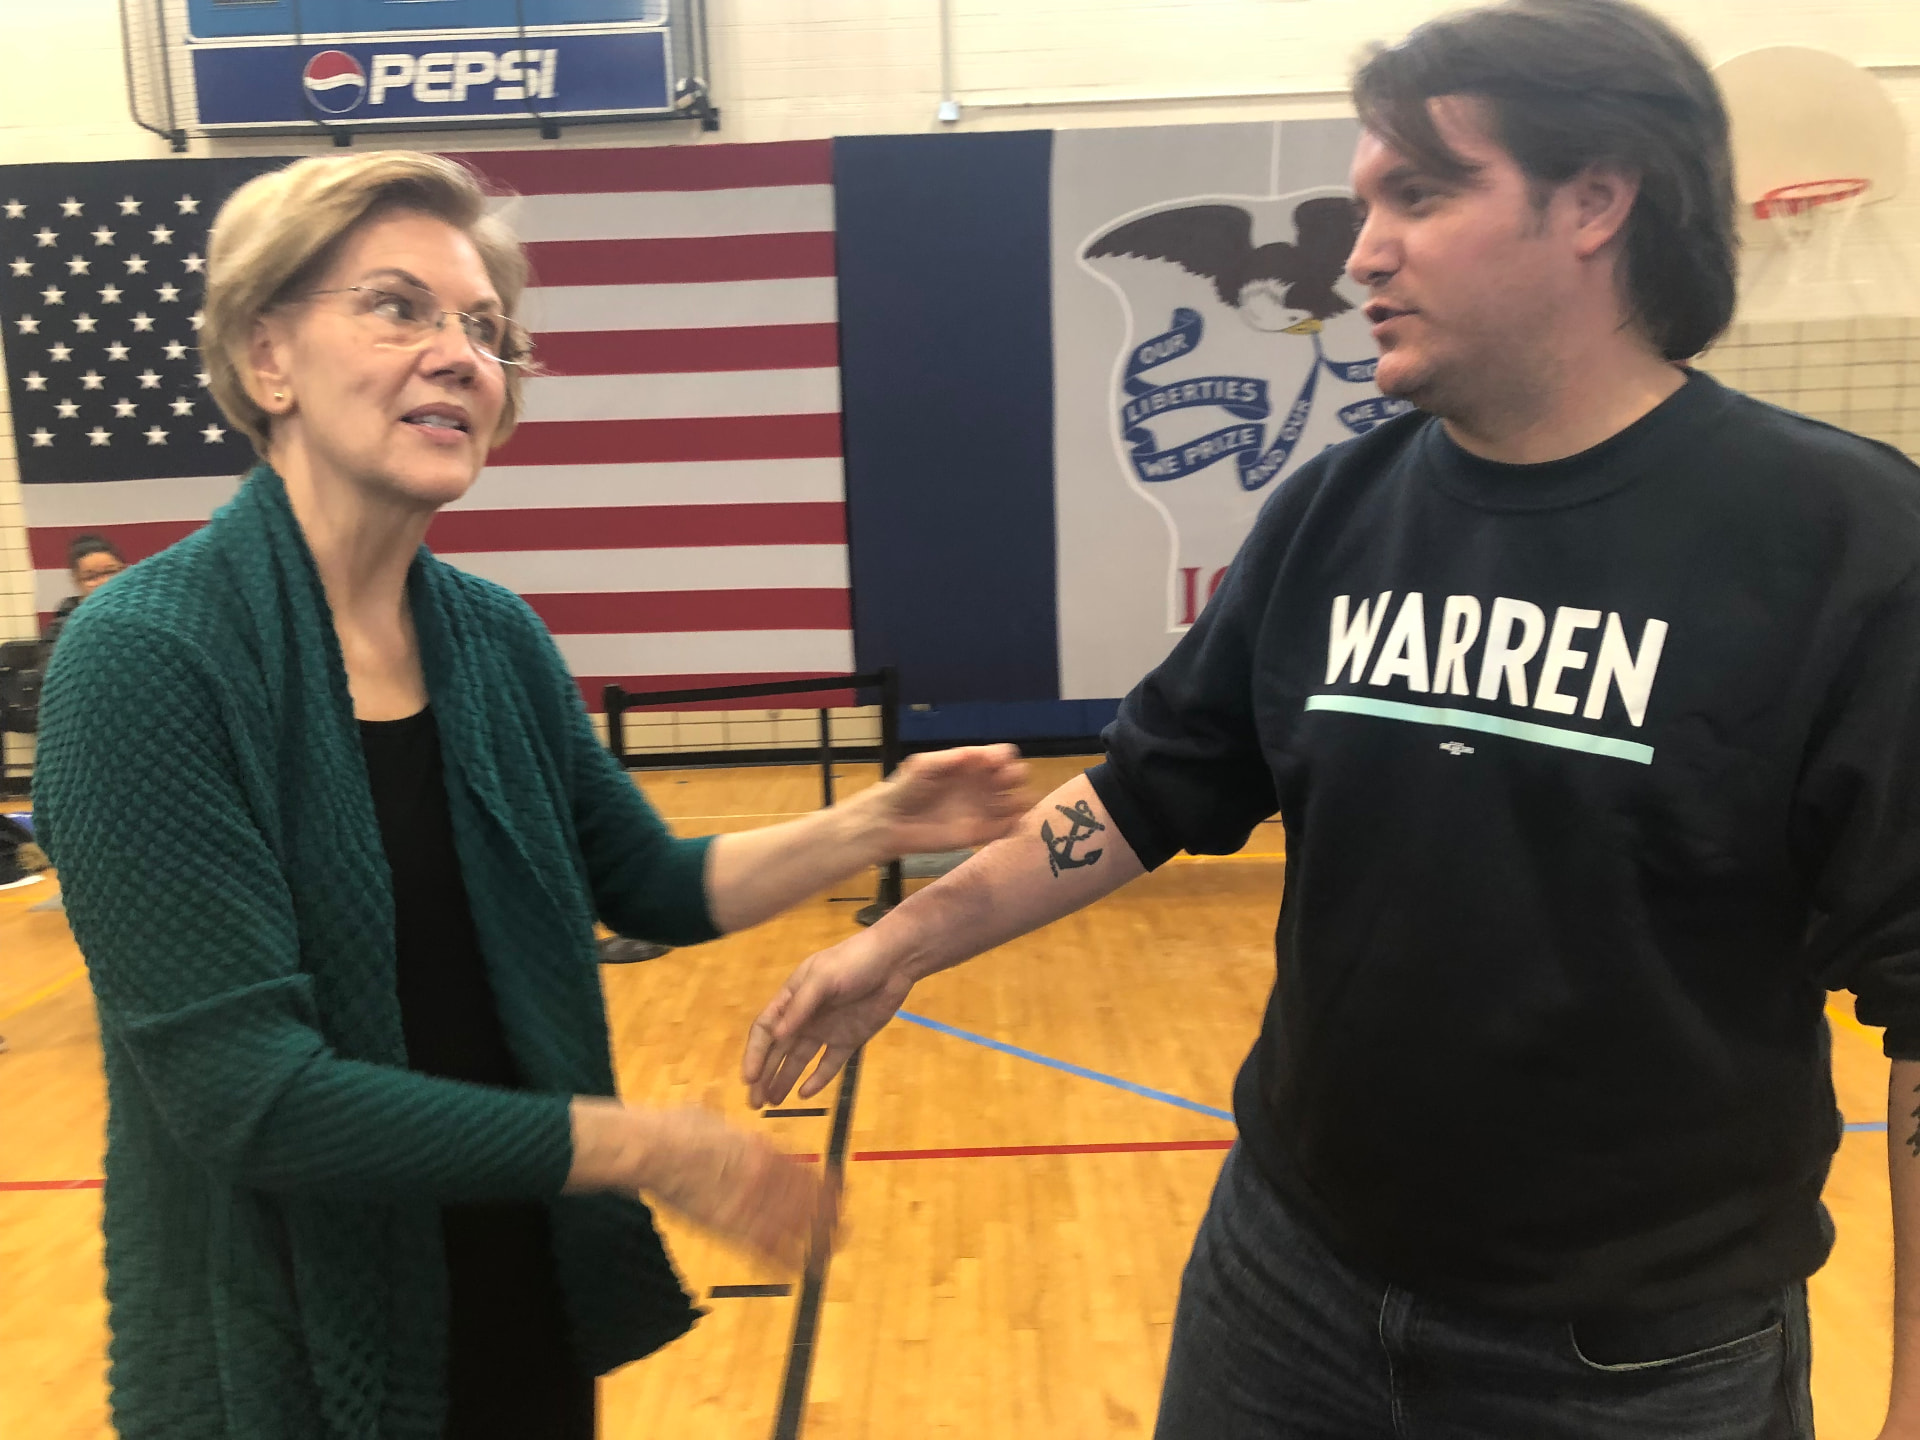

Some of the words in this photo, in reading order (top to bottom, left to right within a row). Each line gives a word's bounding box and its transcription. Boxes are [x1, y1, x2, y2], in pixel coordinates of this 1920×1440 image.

[368, 48, 558, 105] PEPSI
[1140, 333, 1188, 364] OUR
[1127, 380, 1258, 422] LIBERTIES
[1141, 455, 1179, 477] WE
[1184, 427, 1257, 466] PRIZE
[1324, 591, 1669, 727] WARREN
